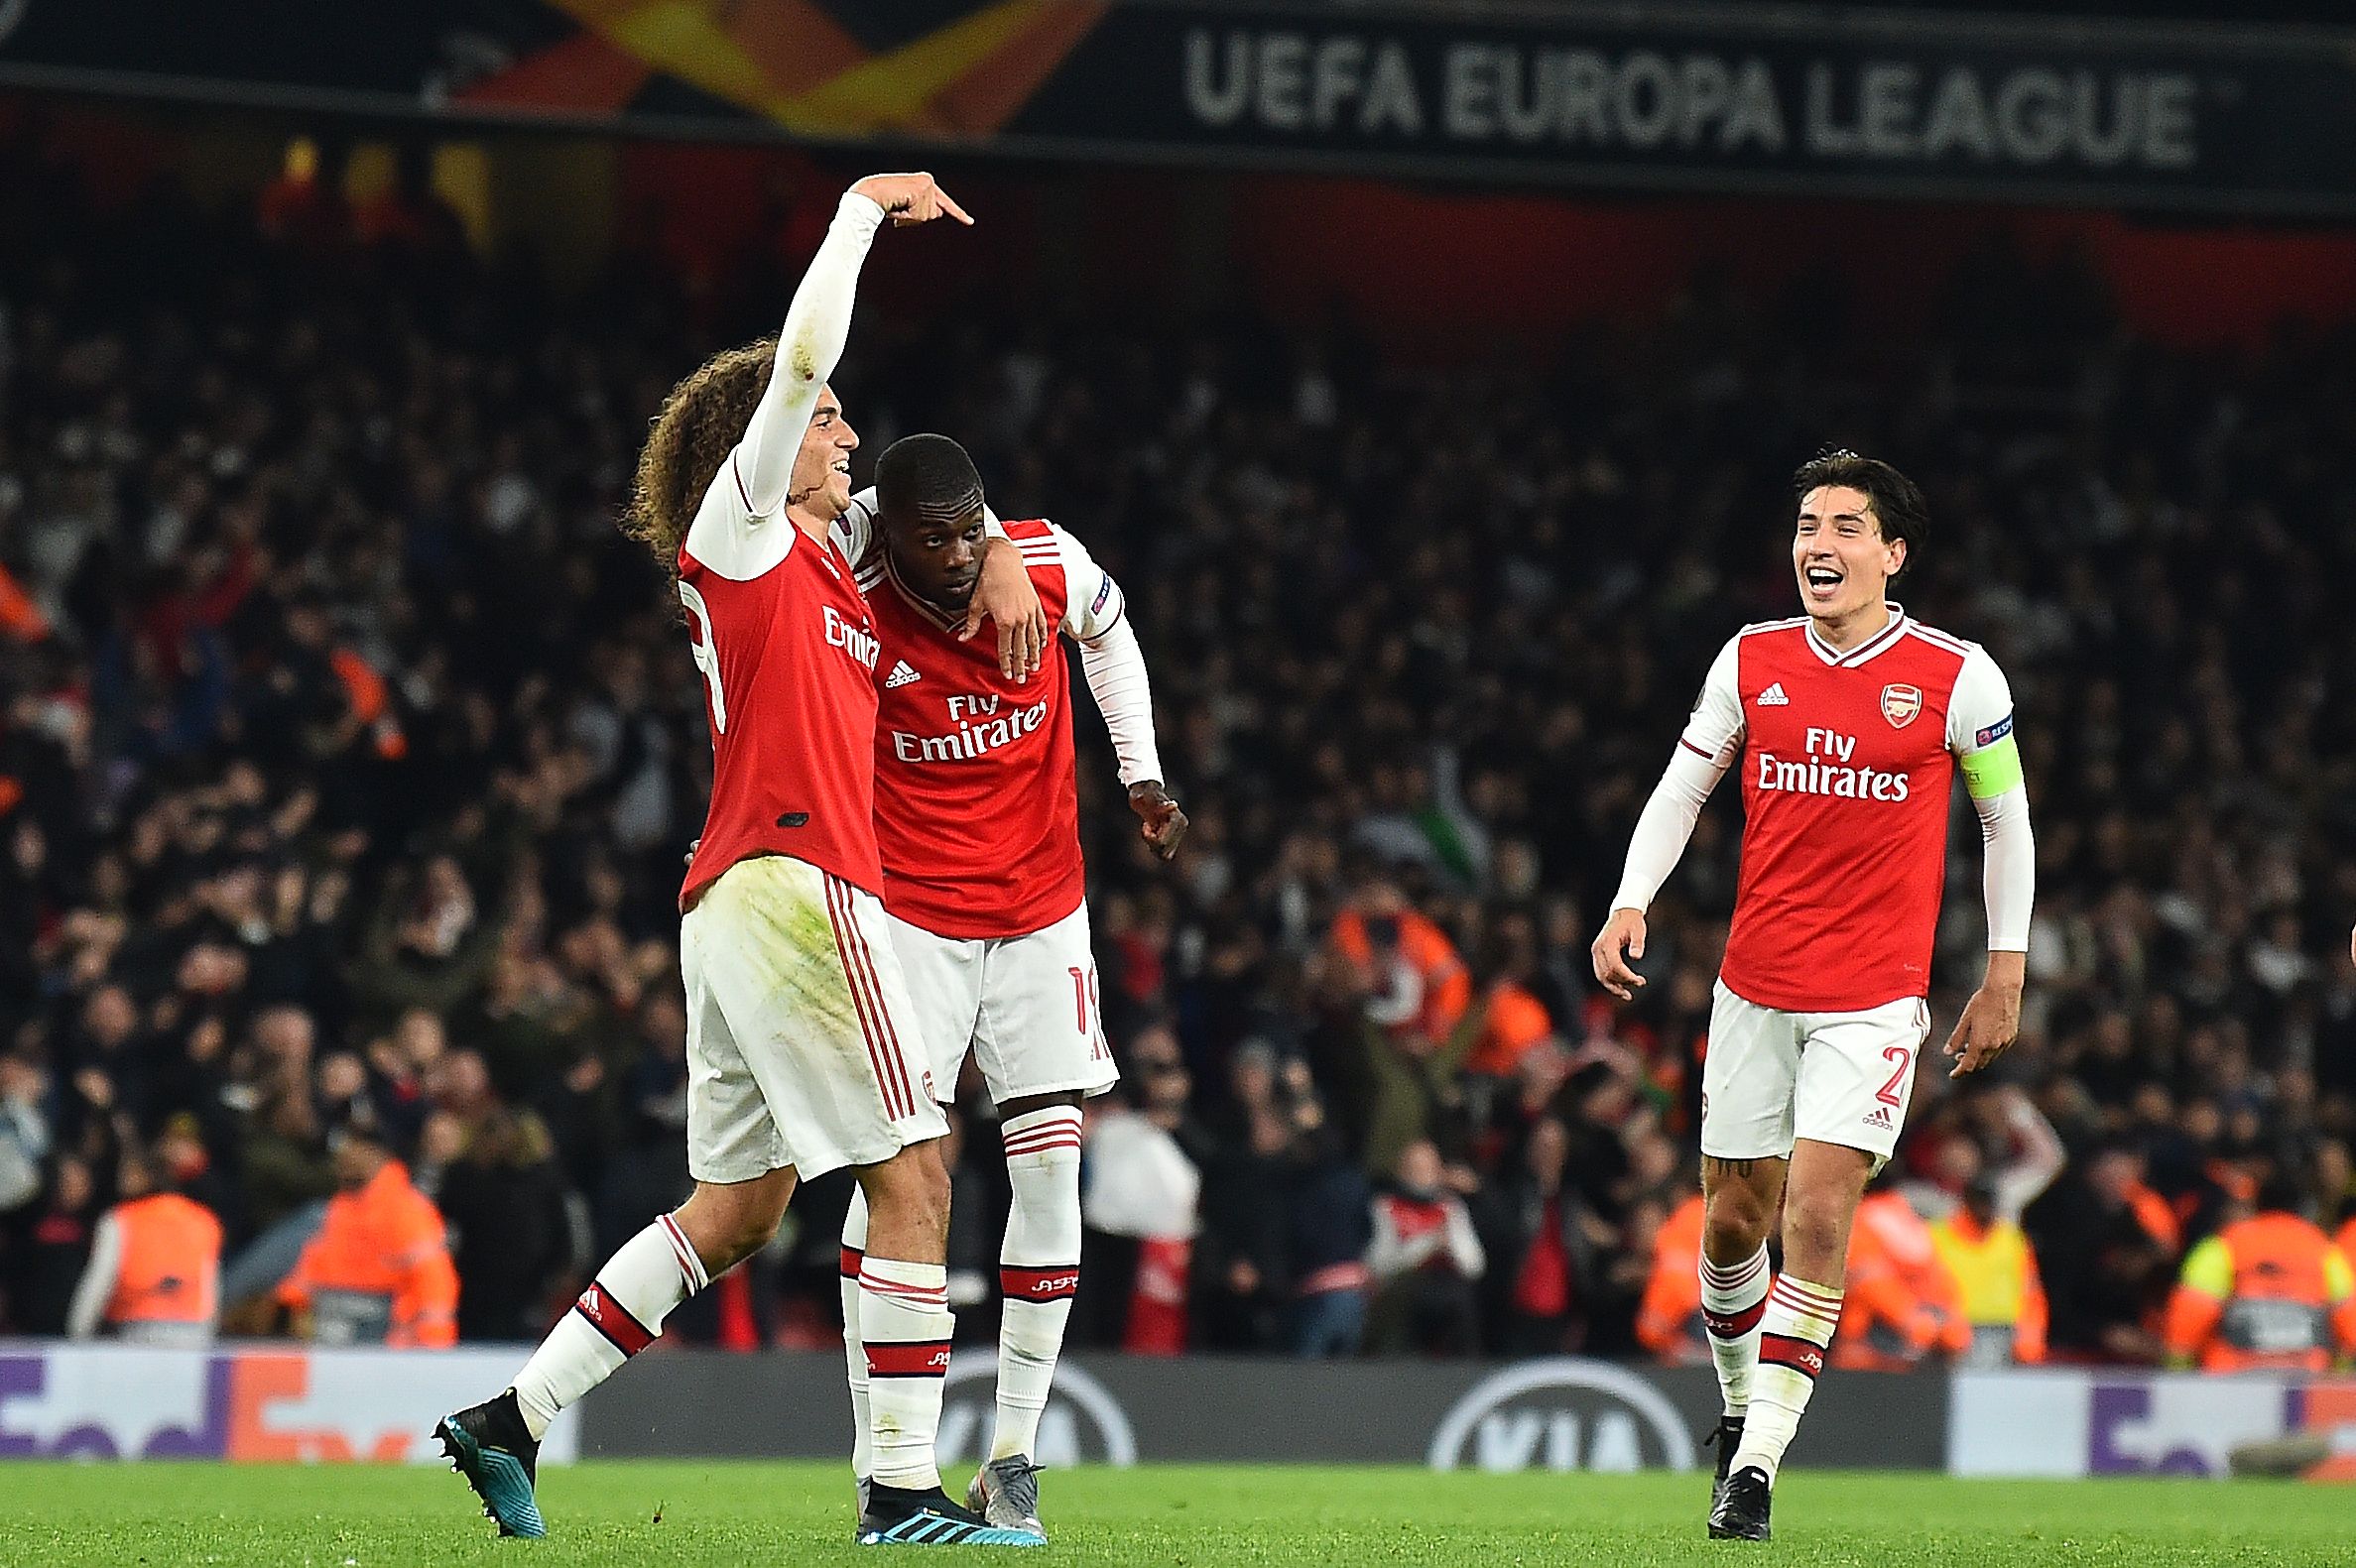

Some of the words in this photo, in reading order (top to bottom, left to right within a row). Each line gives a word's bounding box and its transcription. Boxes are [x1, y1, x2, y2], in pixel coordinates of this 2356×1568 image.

[1185, 31, 1426, 139] UEFA
[1445, 44, 1784, 155] EUROPA
[1805, 61, 2199, 172] LEAGUE
[946, 694, 999, 722] Fly
[1805, 728, 1856, 763] Fly
[1759, 754, 1909, 801] Emirates
[1875, 1046, 1911, 1108] 2
